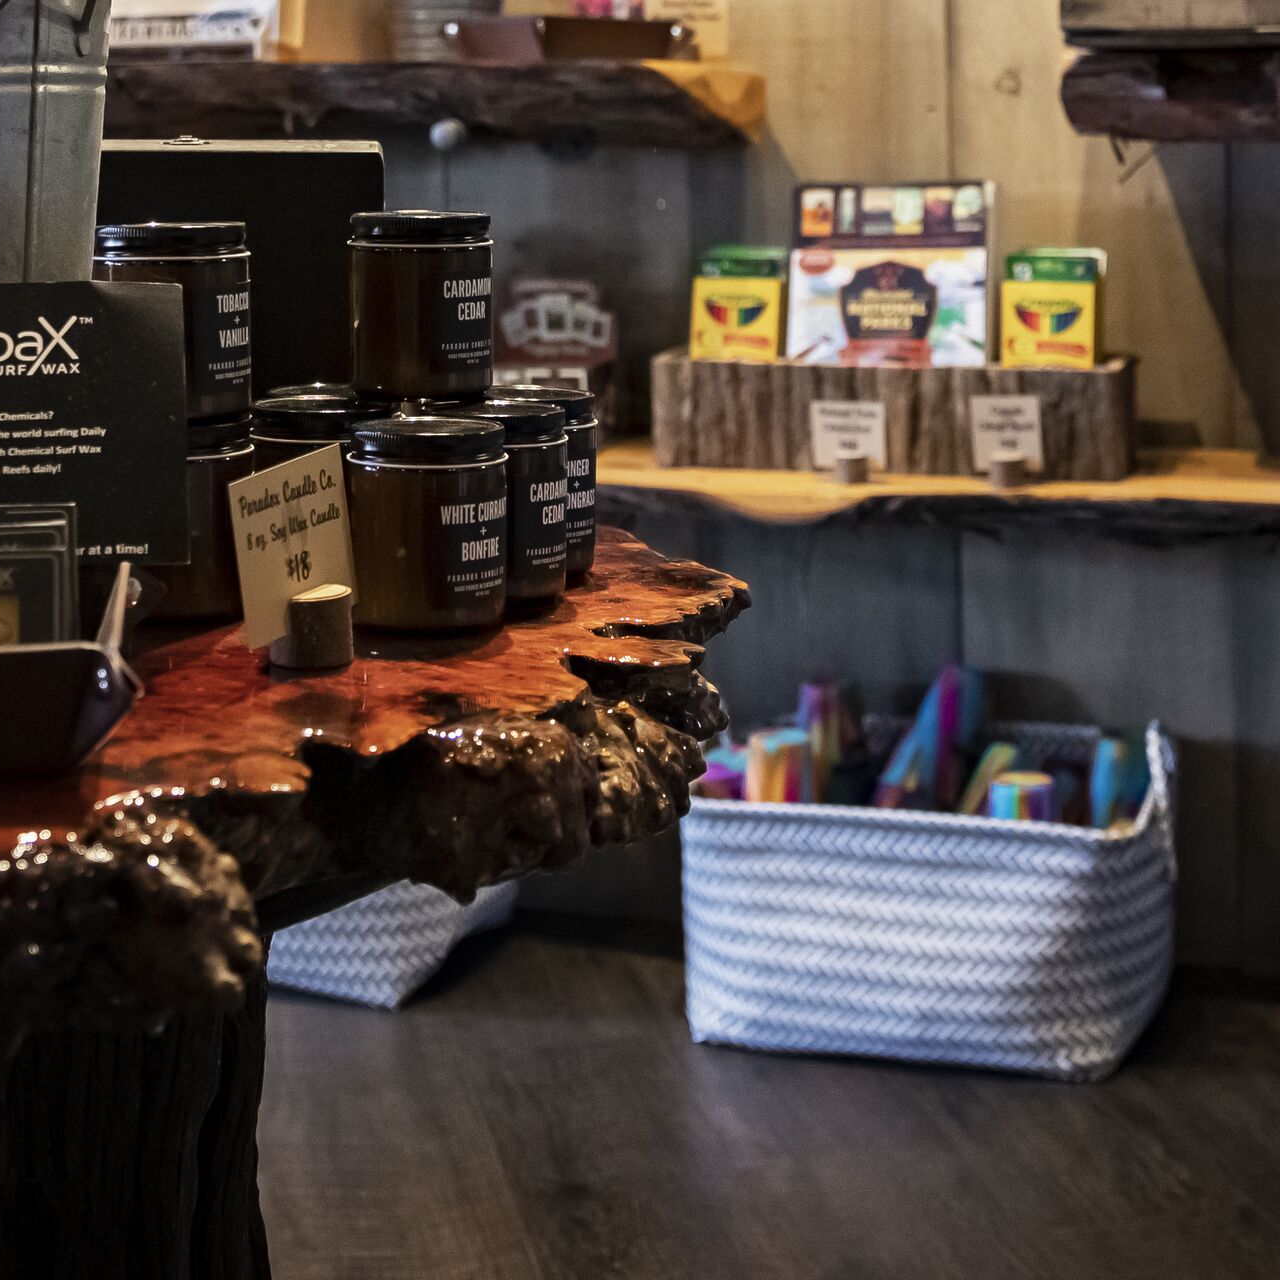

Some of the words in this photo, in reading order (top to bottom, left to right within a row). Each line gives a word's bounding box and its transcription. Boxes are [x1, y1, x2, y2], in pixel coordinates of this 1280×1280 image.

[458, 301, 486, 321] CEDAR
[41, 363, 80, 375] WAX
[12, 429, 42, 439] world
[44, 427, 79, 439] surfing
[81, 427, 106, 438] Daily
[8, 446, 54, 457] Chemical
[55, 445, 77, 455] Surf
[79, 445, 102, 454] Wax
[2, 465, 31, 475] Reefs
[566, 459, 590, 477] INGER
[239, 488, 280, 519] Paradox
[283, 474, 318, 503] Candle
[319, 469, 337, 491] Co.
[530, 477, 567, 503] CARDAMO
[566, 488, 595, 510] ONGRASS
[441, 504, 476, 525] WHITE
[246, 532, 253, 551] 8
[270, 521, 287, 543] Soy
[289, 516, 309, 535] Wax
[310, 503, 341, 528] Candle
[89, 545, 101, 556] at
[104, 546, 113, 555] a
[116, 543, 149, 555] time!
[462, 536, 500, 562] BONFIRE
[287, 550, 312, 583] $18
